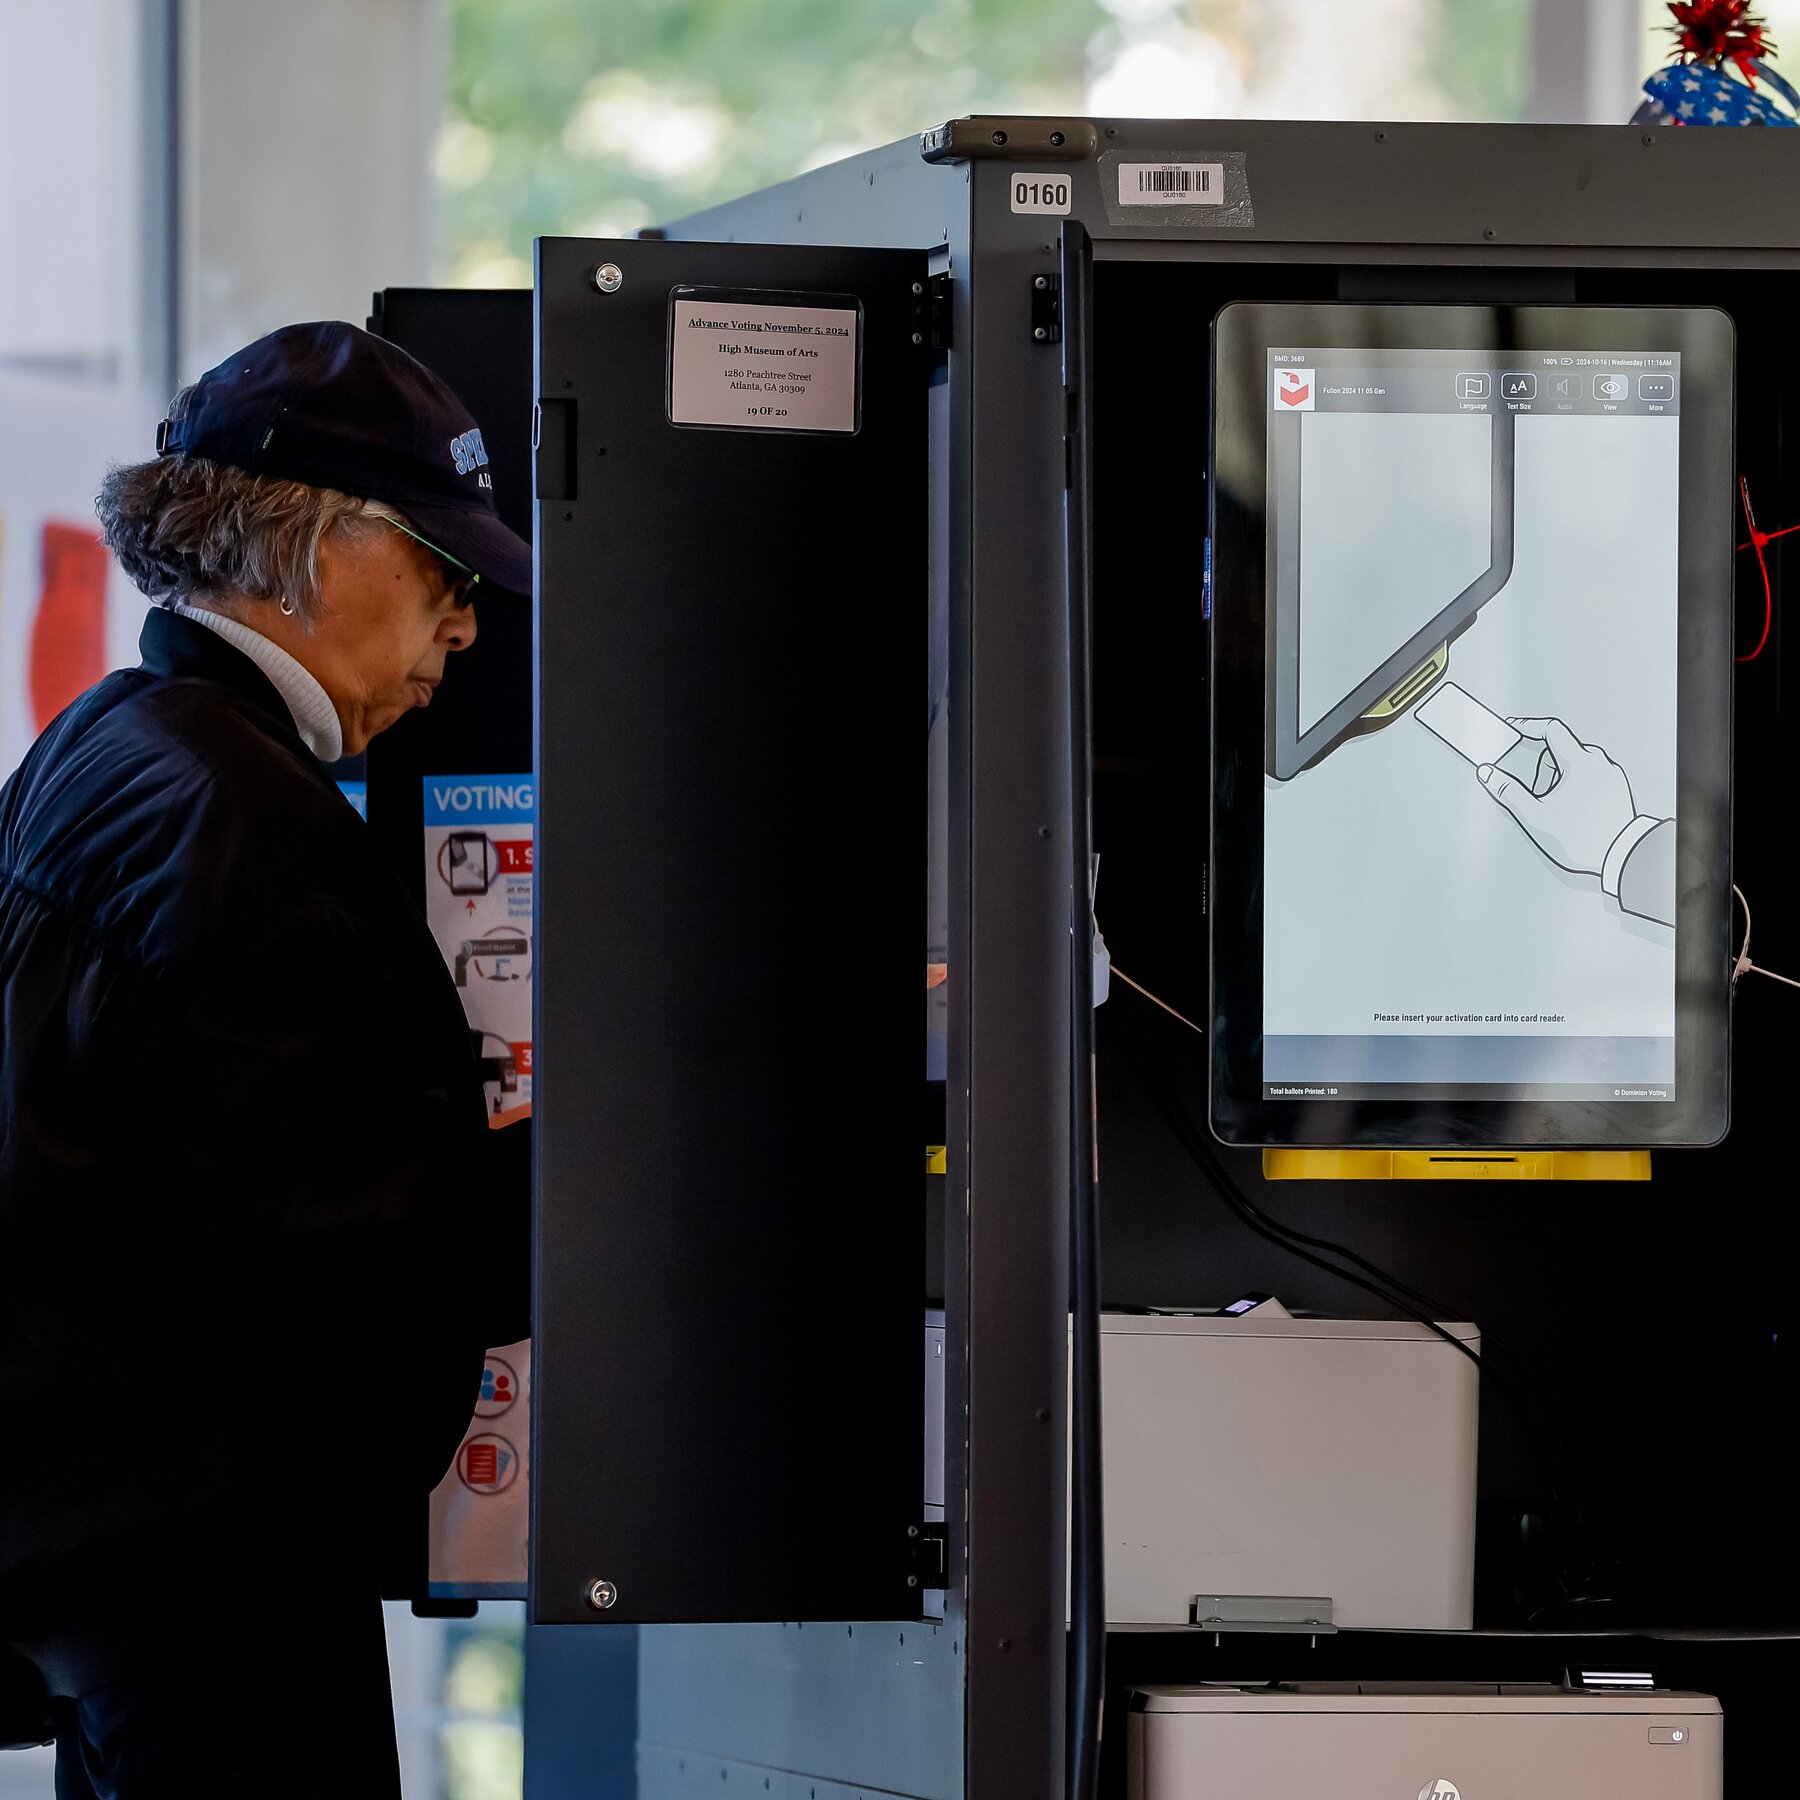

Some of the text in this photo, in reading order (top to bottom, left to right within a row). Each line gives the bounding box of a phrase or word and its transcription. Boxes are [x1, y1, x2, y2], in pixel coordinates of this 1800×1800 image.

[1015, 182, 1067, 206] 0160
[688, 318, 729, 329] Advance
[731, 321, 763, 332] Voting
[764, 322, 813, 333] November
[825, 327, 849, 336] 2024
[718, 344, 818, 358] High Museum of Arts
[1576, 358, 1607, 366] 2024-10-16
[1612, 359, 1643, 368] Wednesday
[1647, 359, 1672, 367] 11:16AM
[724, 369, 812, 381] 1280 Peachtree Street
[729, 381, 805, 394] Atlanta, GA 30309
[747, 407, 788, 416] 19 OF 20
[1459, 403, 1487, 411] Language
[433, 785, 533, 812] VOTING
[506, 848, 520, 865] 1.
[1374, 1013, 1566, 1023] Please insert your activation card into card reader.
